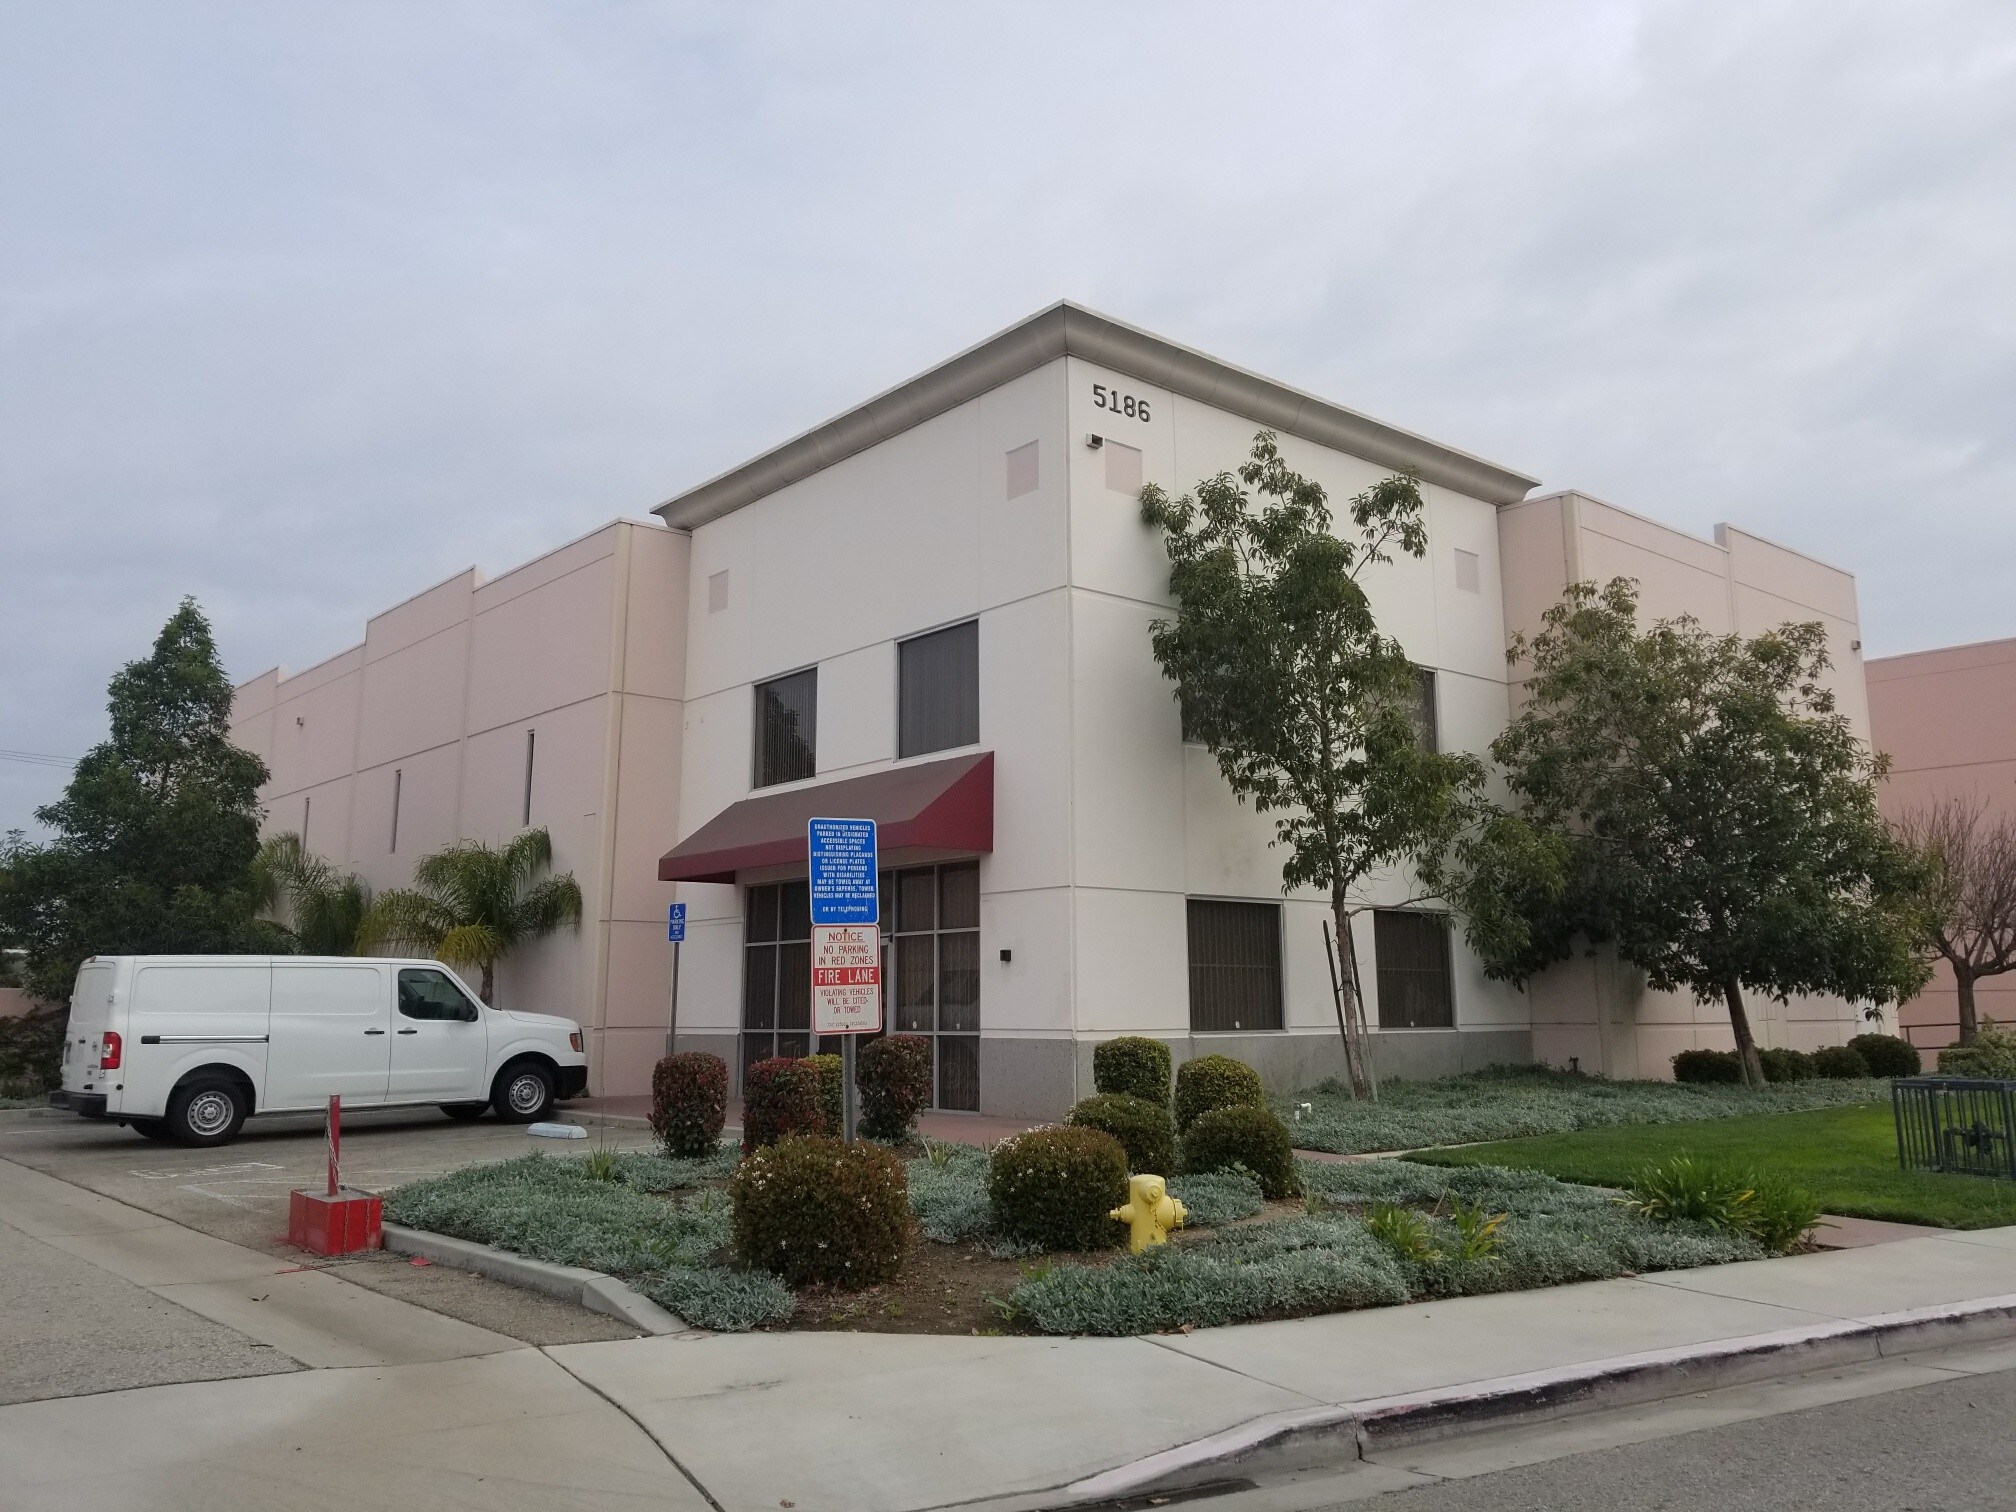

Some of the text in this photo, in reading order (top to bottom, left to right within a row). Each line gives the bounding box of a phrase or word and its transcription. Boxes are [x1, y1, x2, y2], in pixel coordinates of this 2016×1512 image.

[1093, 383, 1151, 423] 5186
[829, 932, 863, 941] NOTICE
[824, 945, 868, 954] NO PARKING
[819, 956, 873, 965] IN RED ZONES
[818, 969, 874, 983] FIRE LANE
